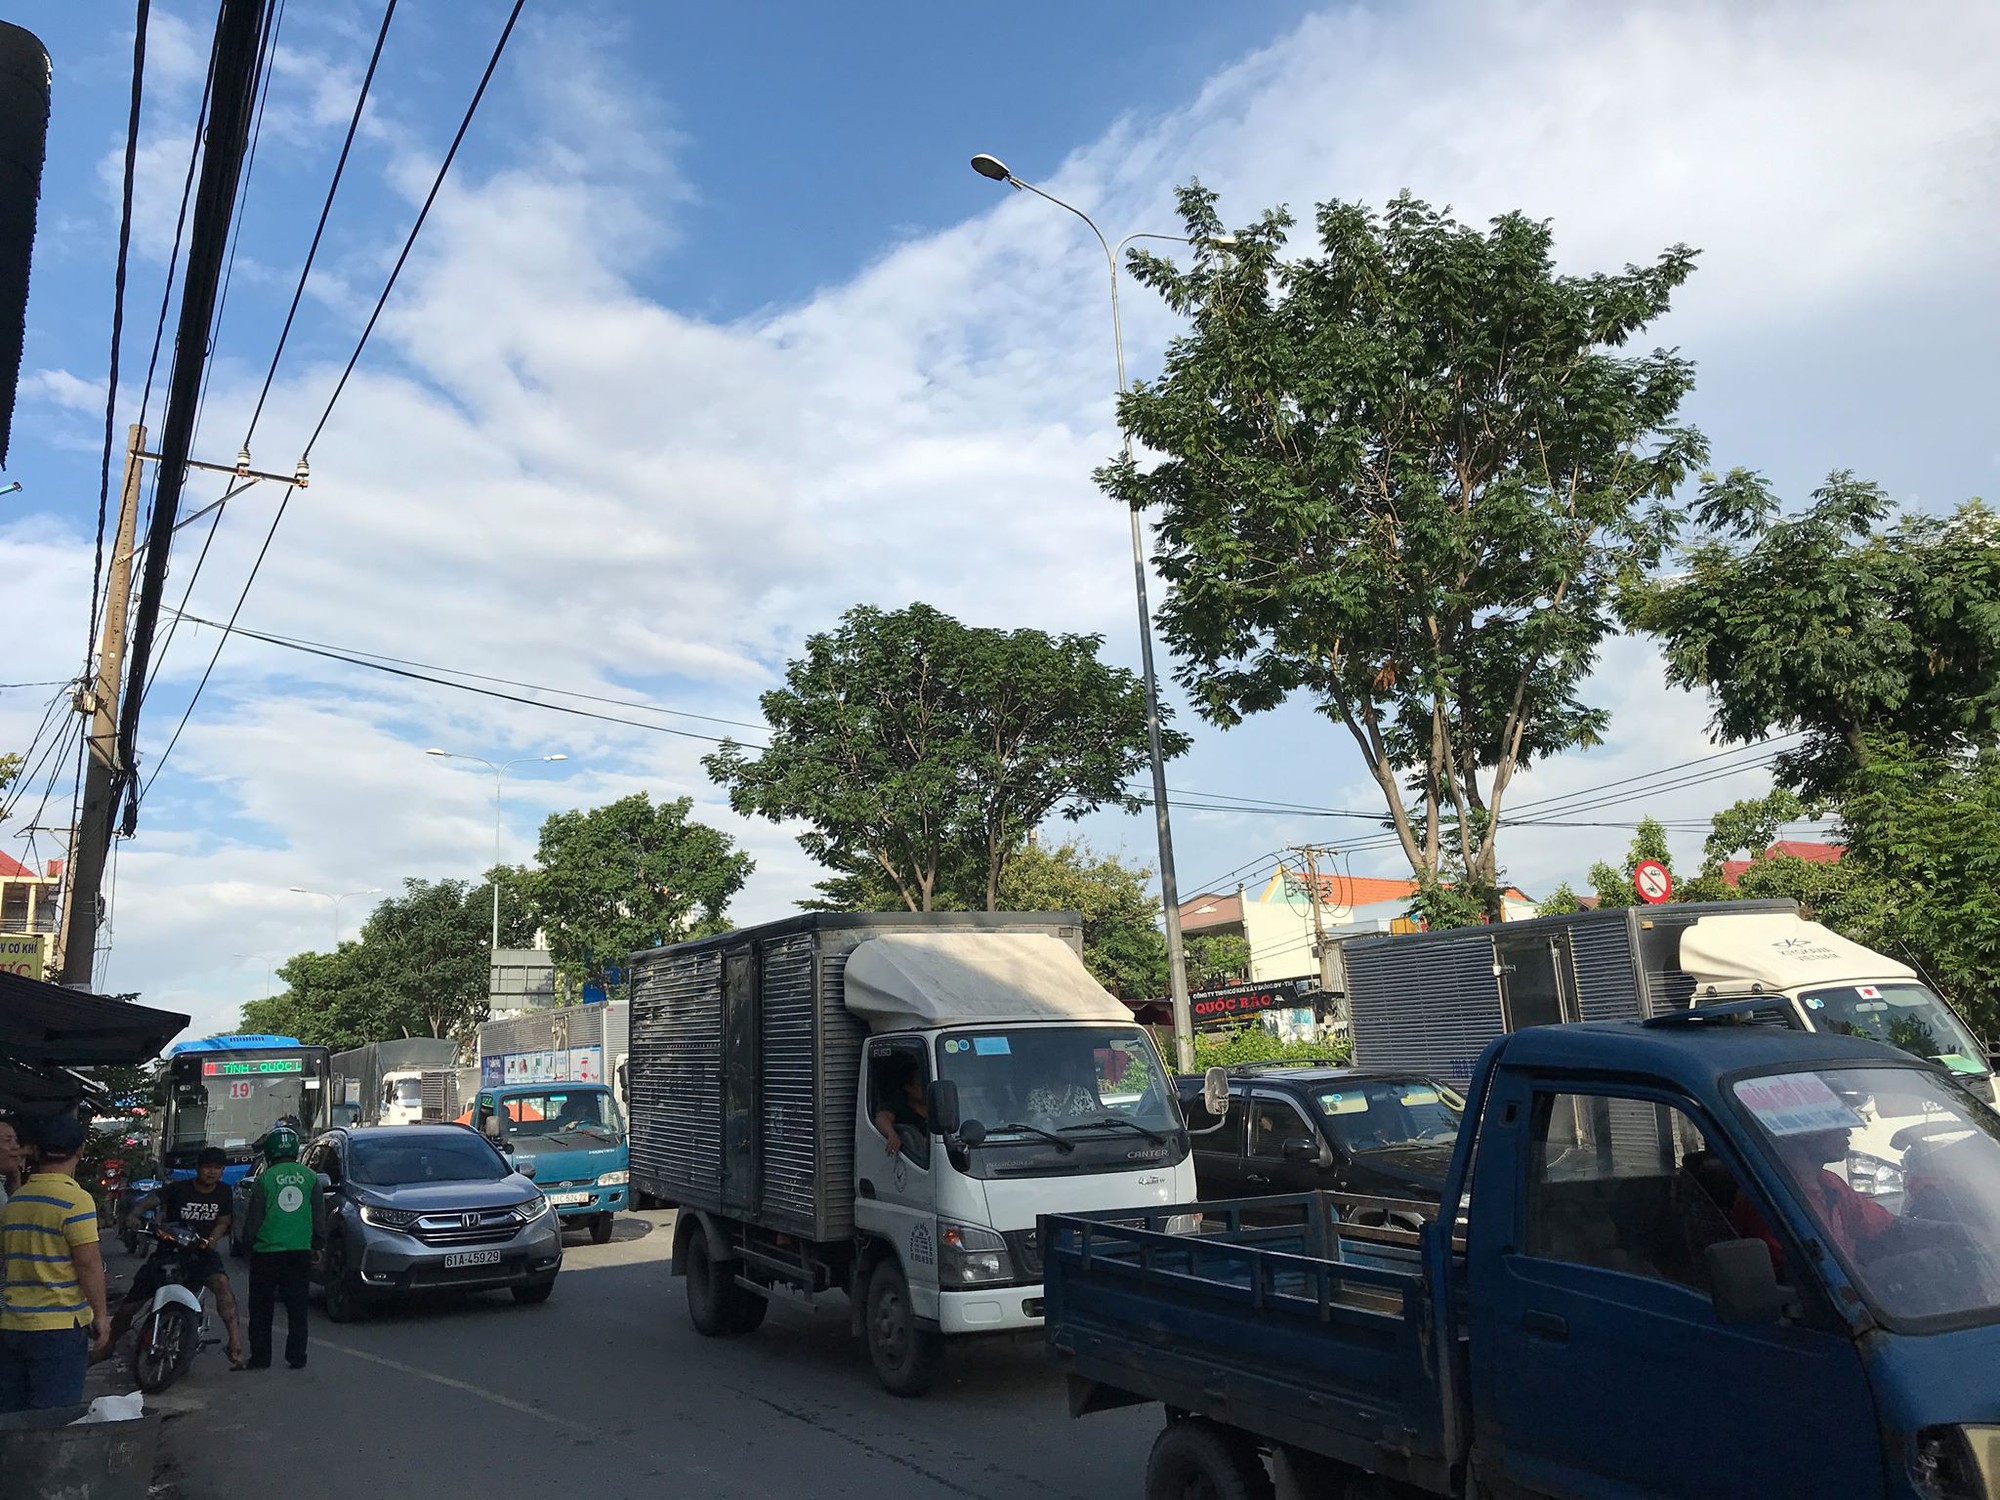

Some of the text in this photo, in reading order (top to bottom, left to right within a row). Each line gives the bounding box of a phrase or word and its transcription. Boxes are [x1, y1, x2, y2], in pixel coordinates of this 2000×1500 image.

[1195, 992, 1272, 1014] QUỐC BẢO
[260, 1060, 292, 1072] QUỐC
[231, 1082, 249, 1098] 19
[1127, 1149, 1169, 1159] CANTER
[276, 1172, 305, 1185] Grab
[181, 1202, 219, 1212] STAR
[180, 1210, 218, 1221] WARS
